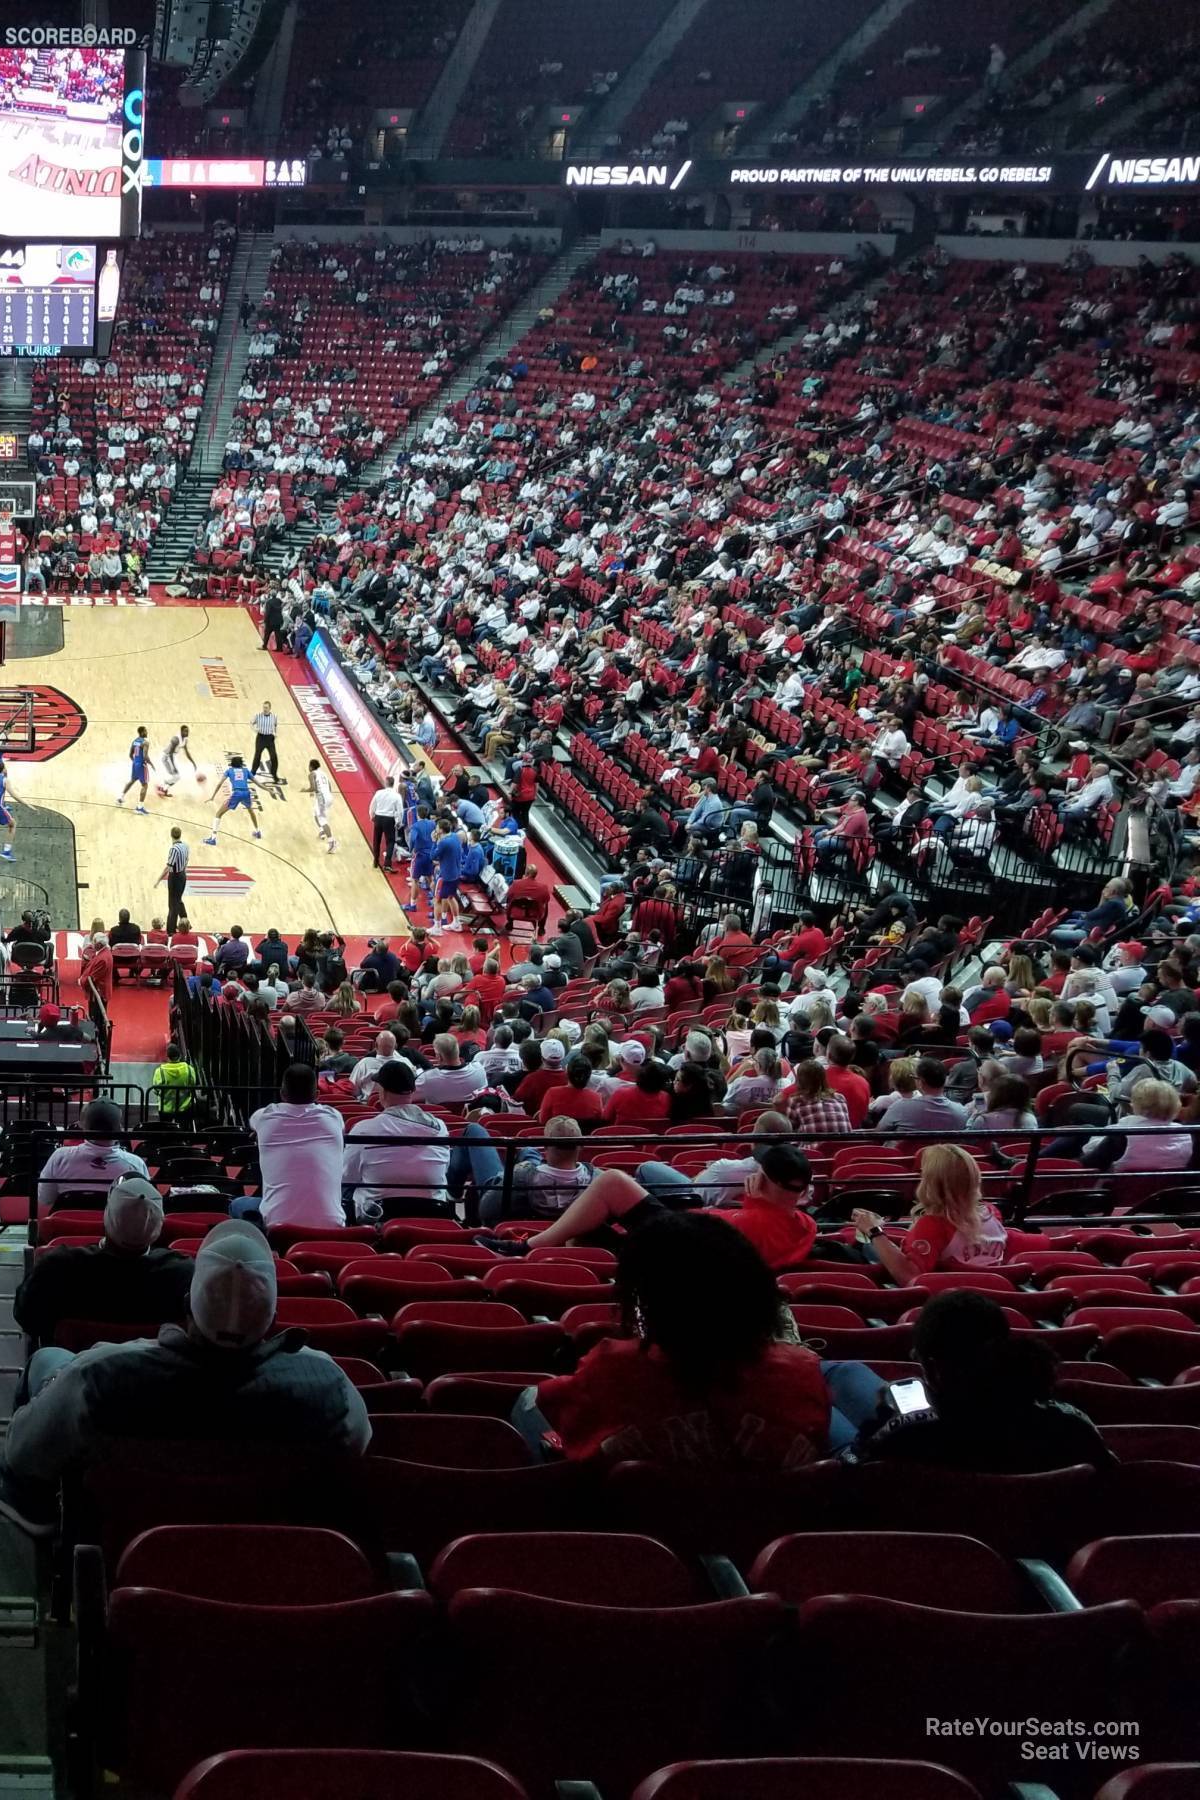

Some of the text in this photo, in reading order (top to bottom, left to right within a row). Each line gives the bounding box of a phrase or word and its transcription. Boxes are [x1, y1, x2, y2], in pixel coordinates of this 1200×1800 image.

[5, 27, 137, 45] SCOREBOARD
[122, 89, 143, 195] COX
[565, 166, 667, 185] NISSAN
[730, 167, 1052, 183] PROUD PARTNER OF THE UNLV REBELS. GO REBELS!
[1108, 157, 1200, 184] NISSAN
[15, 345, 61, 356] TURF
[21, 595, 156, 606] REBELS
